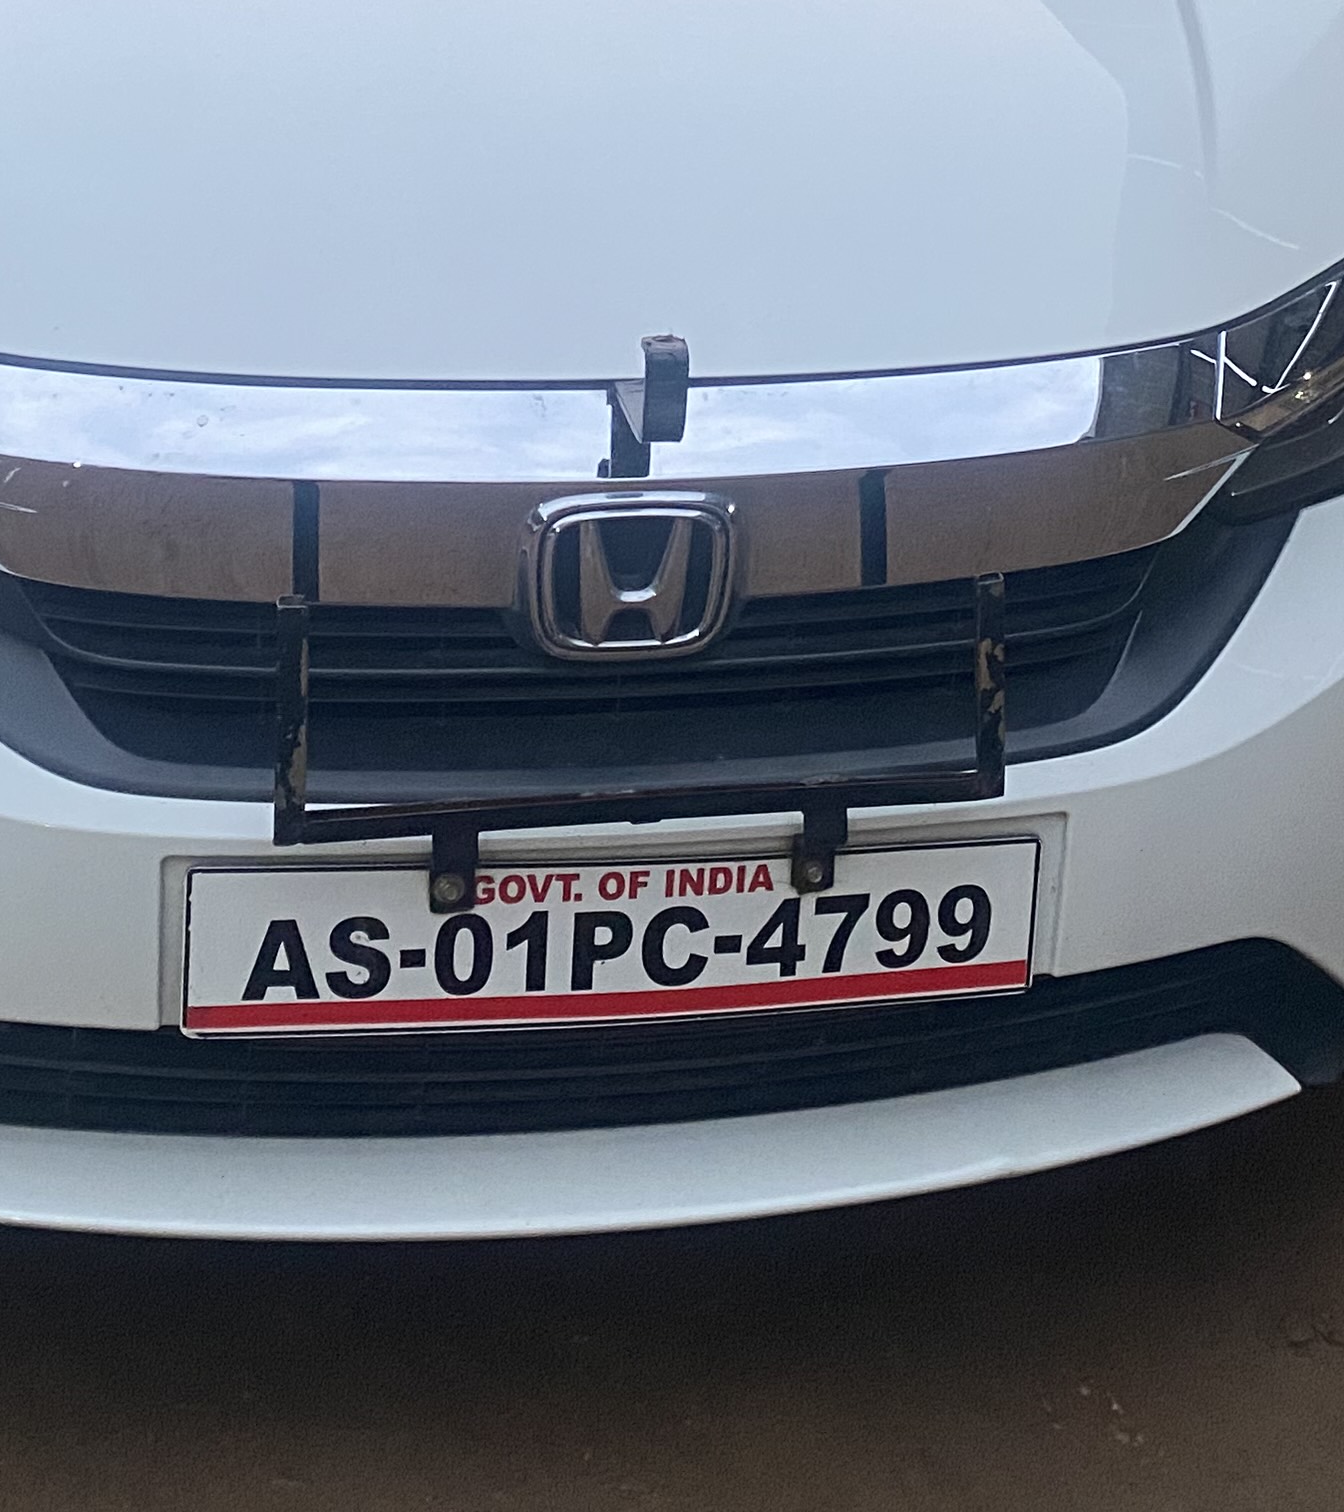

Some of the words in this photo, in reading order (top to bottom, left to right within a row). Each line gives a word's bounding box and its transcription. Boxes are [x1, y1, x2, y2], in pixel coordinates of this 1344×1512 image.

[474, 873, 583, 905] GOVT.
[598, 870, 651, 900] OF
[664, 864, 775, 898] INDIA
[241, 884, 992, 1001] AS-01PC-4799
